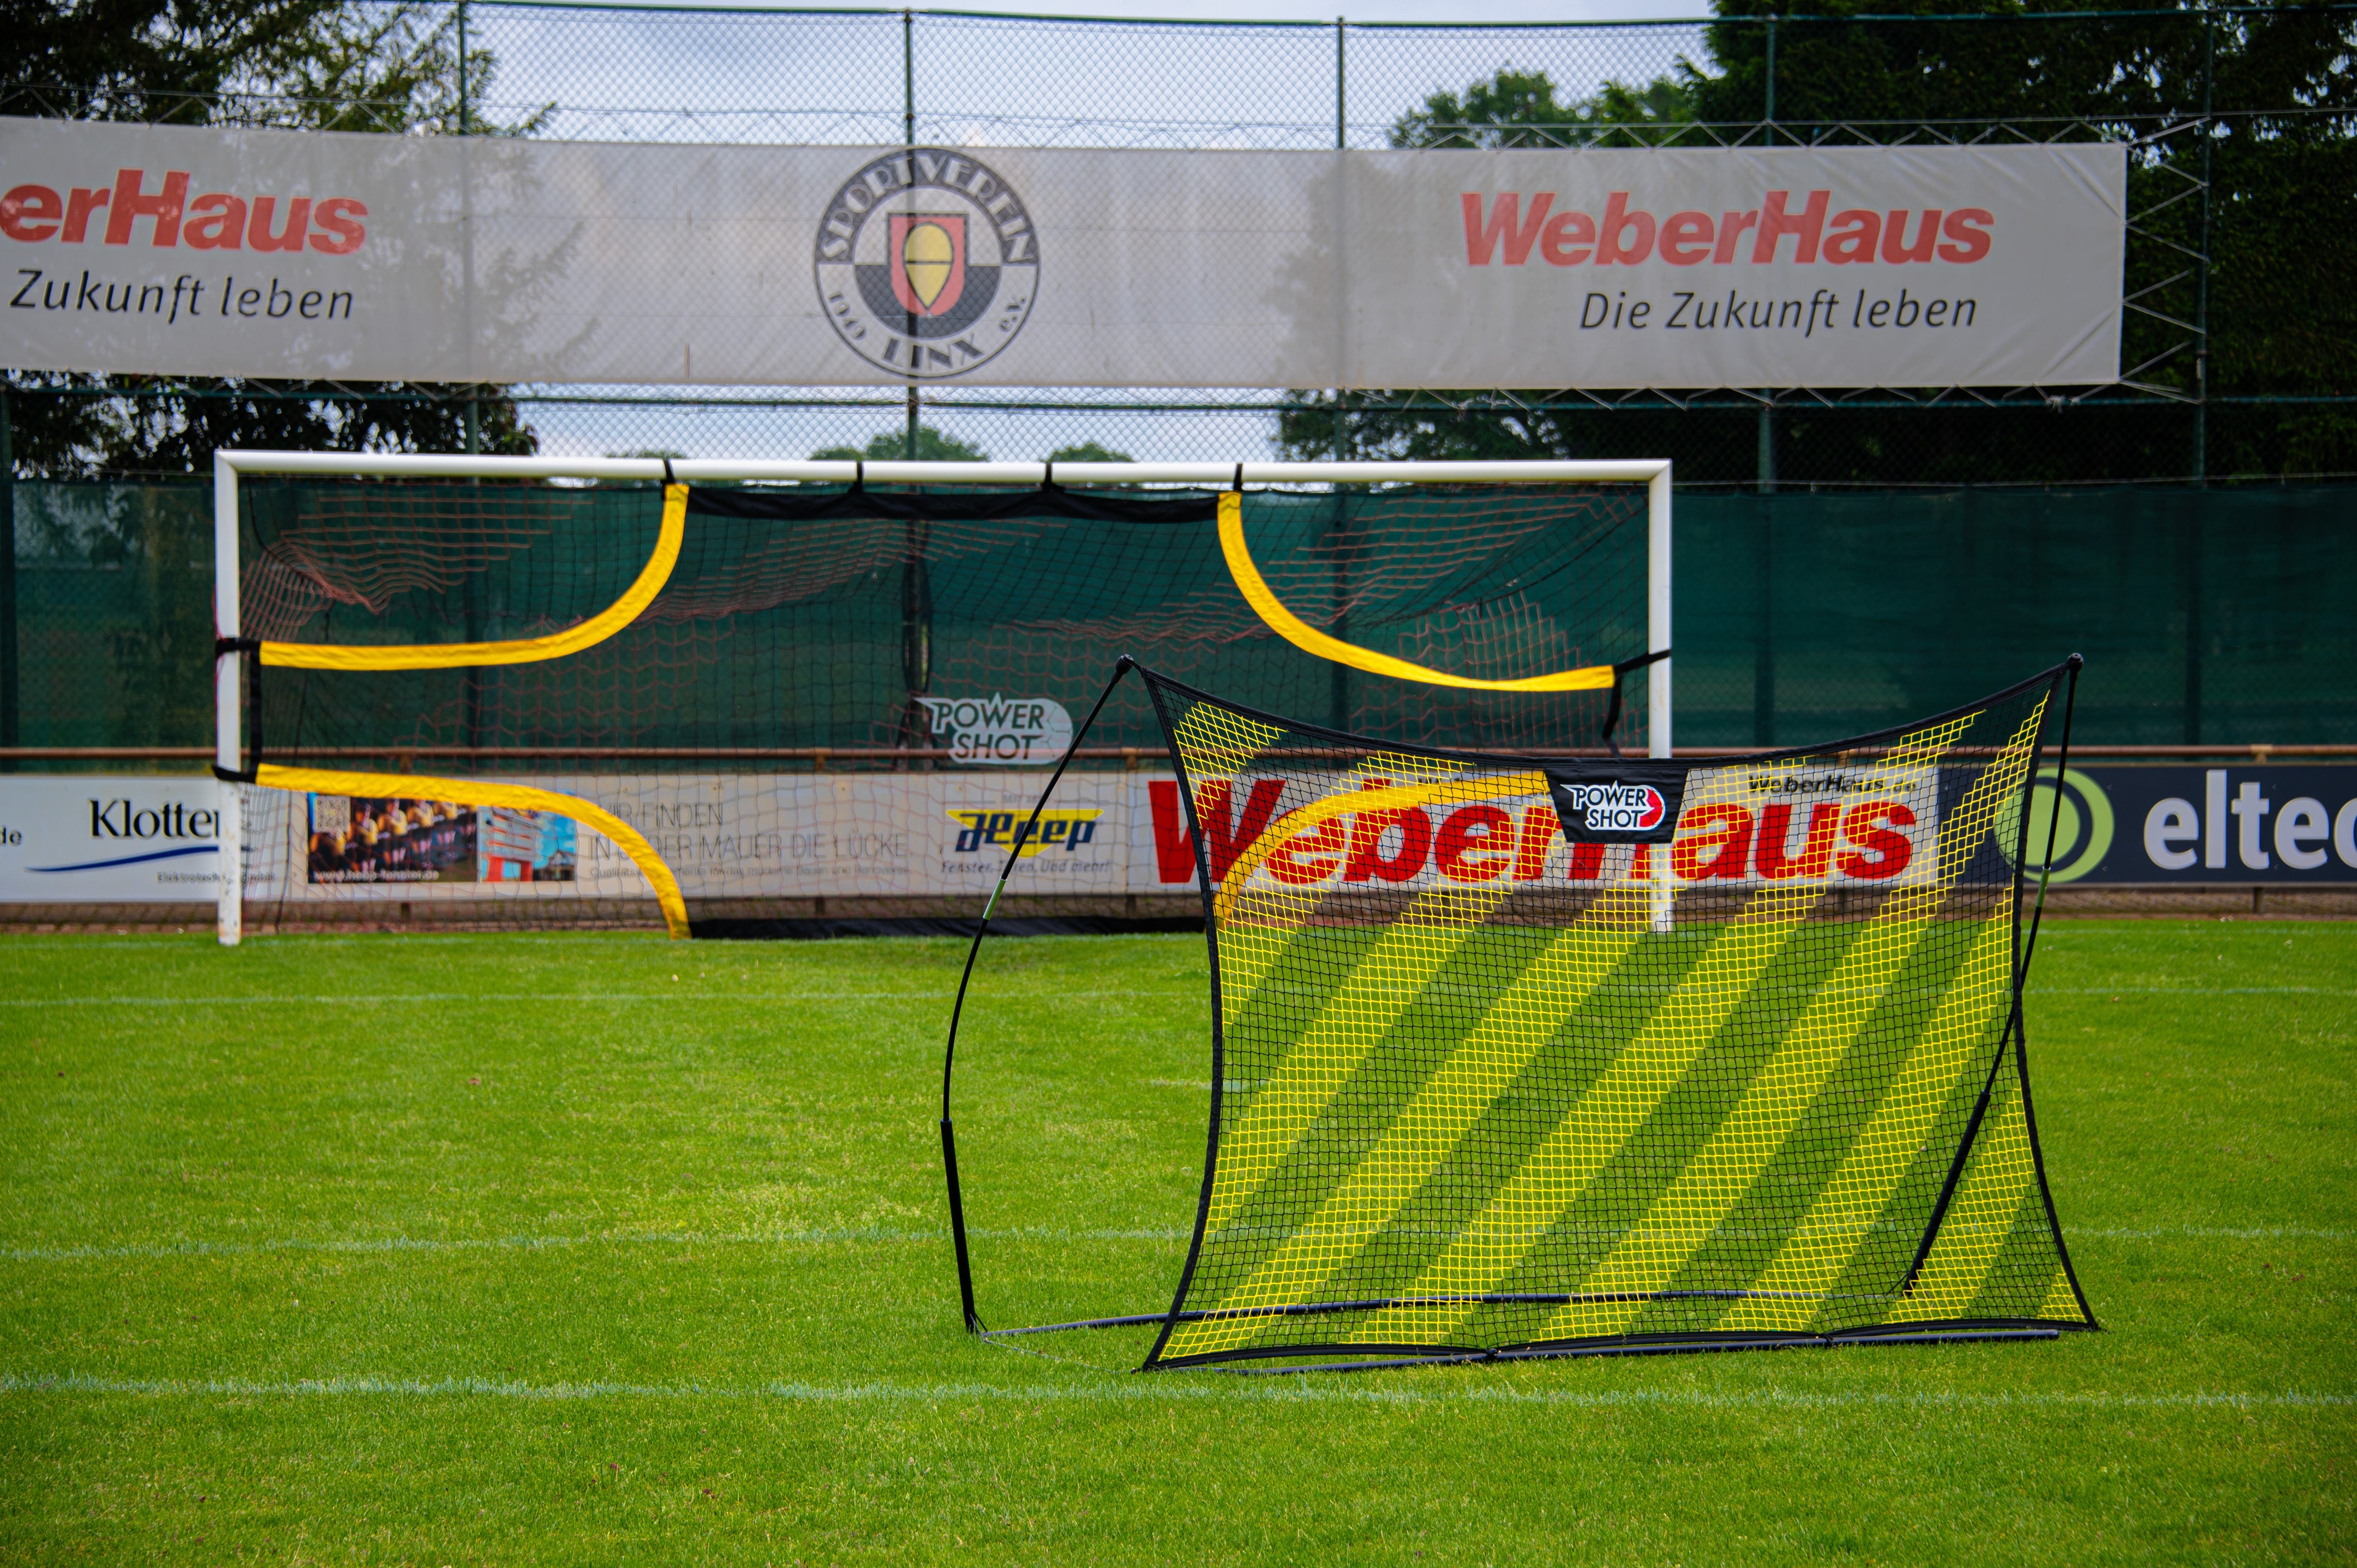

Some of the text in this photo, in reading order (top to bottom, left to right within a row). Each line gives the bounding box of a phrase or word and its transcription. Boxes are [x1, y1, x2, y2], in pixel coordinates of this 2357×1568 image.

[0, 167, 369, 256] erHaus
[821, 153, 1034, 262] SPORTVEREIN
[1460, 189, 1994, 267] WeberHaus
[10, 268, 354, 324] Zukunft leben
[1578, 288, 1977, 338] Die Zukunft leben
[931, 702, 1044, 730] POWER
[954, 733, 1044, 760] SHOT
[1571, 787, 1647, 808] POWER
[643, 802, 723, 827] FINDEN
[1588, 809, 1648, 828] SHOT
[702, 834, 782, 859] MAUER
[792, 834, 827, 858] DIE
